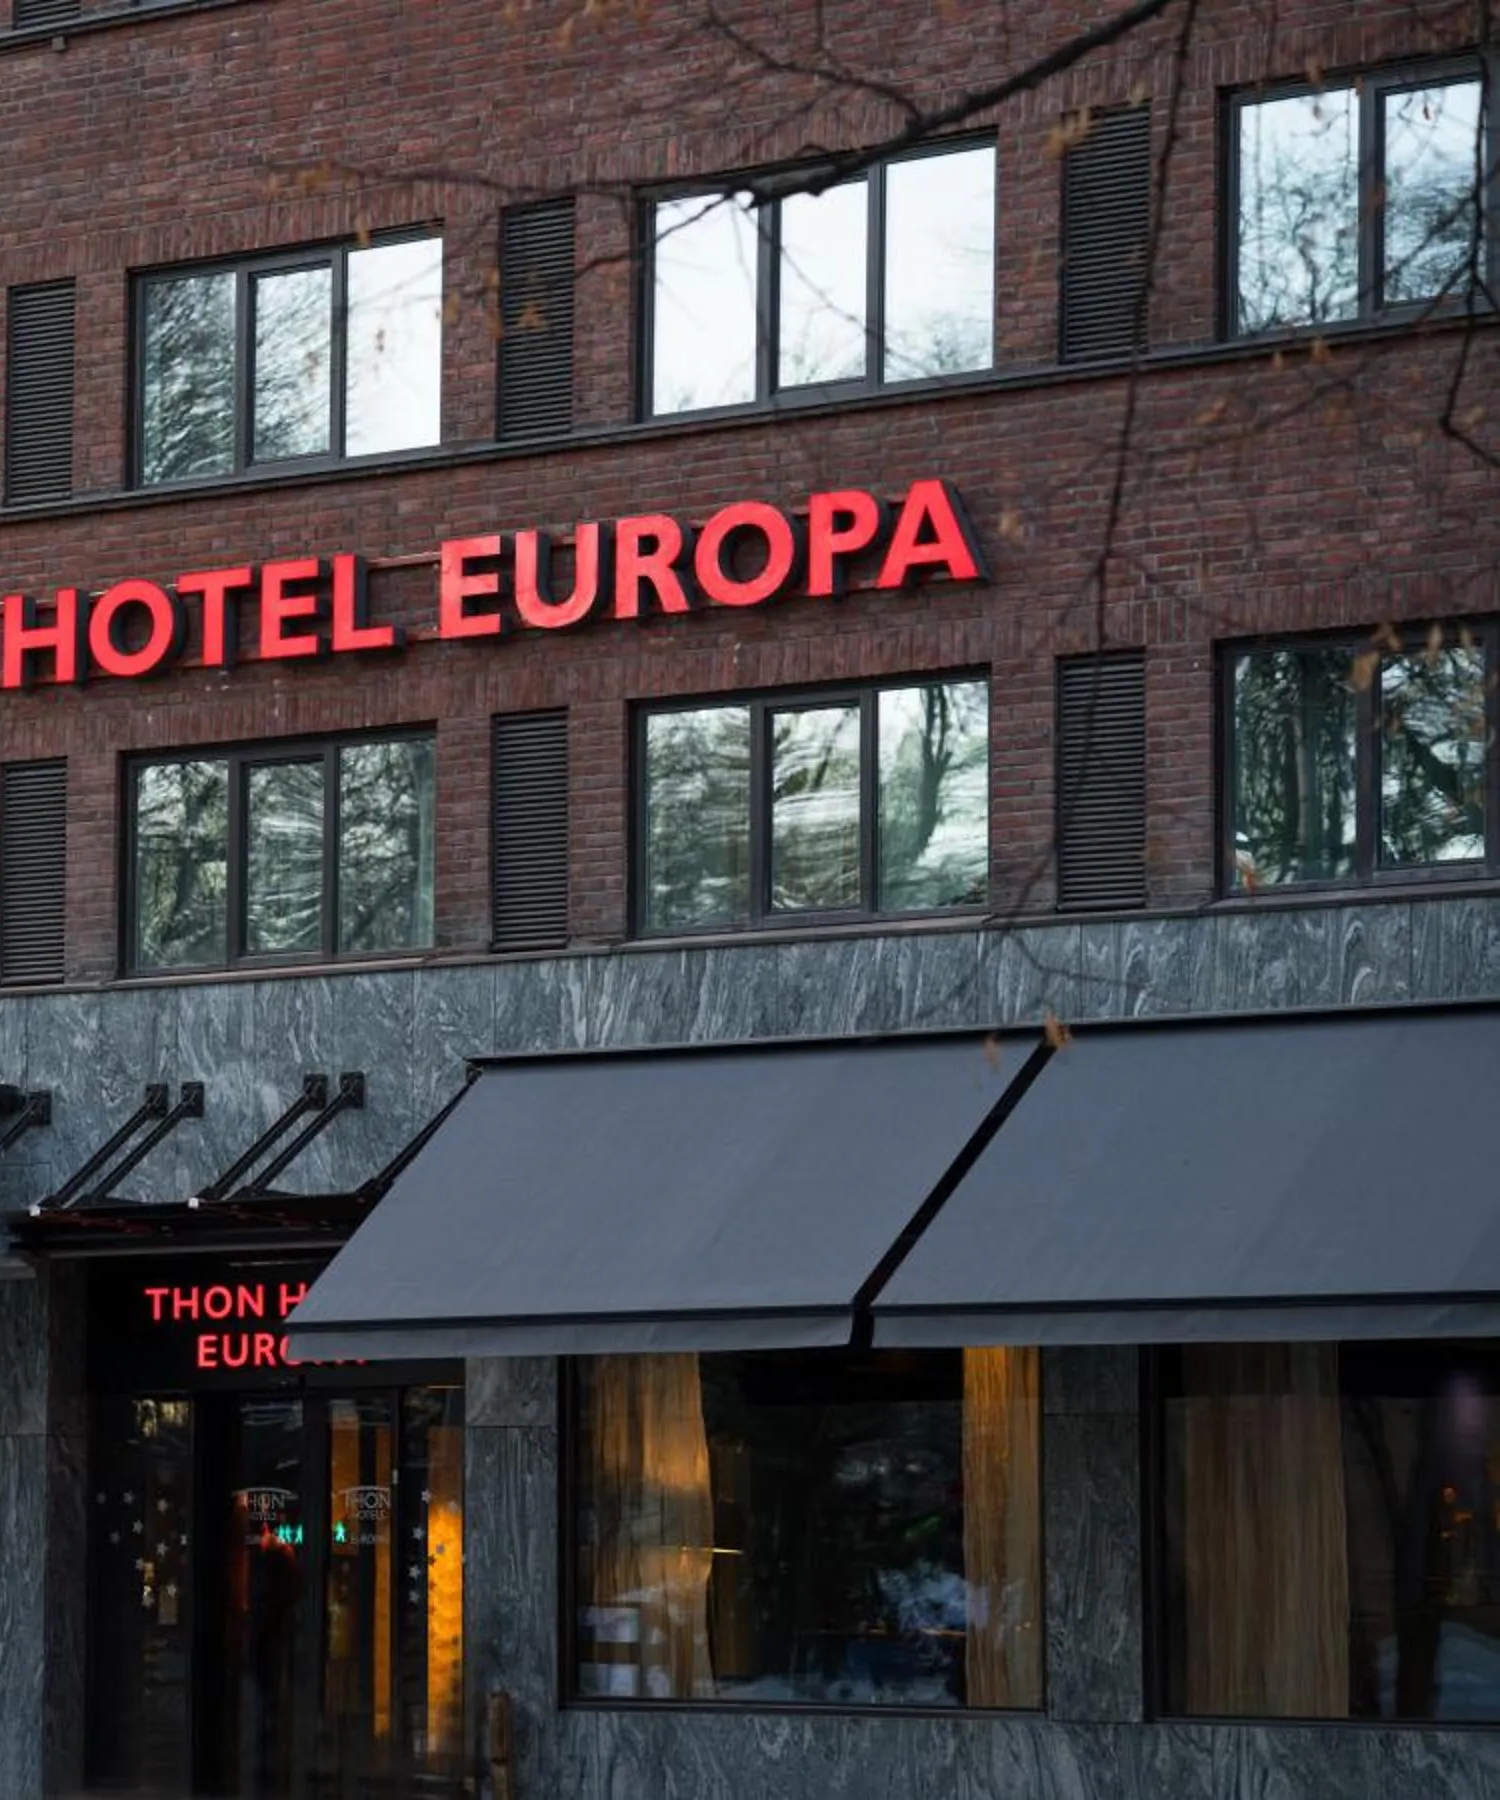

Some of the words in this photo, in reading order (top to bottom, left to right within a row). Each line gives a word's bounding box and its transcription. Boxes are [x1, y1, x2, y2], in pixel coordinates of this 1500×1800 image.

[3, 553, 398, 689] HOTEL
[439, 479, 984, 640] EUROPA
[145, 1283, 264, 1321] THON
